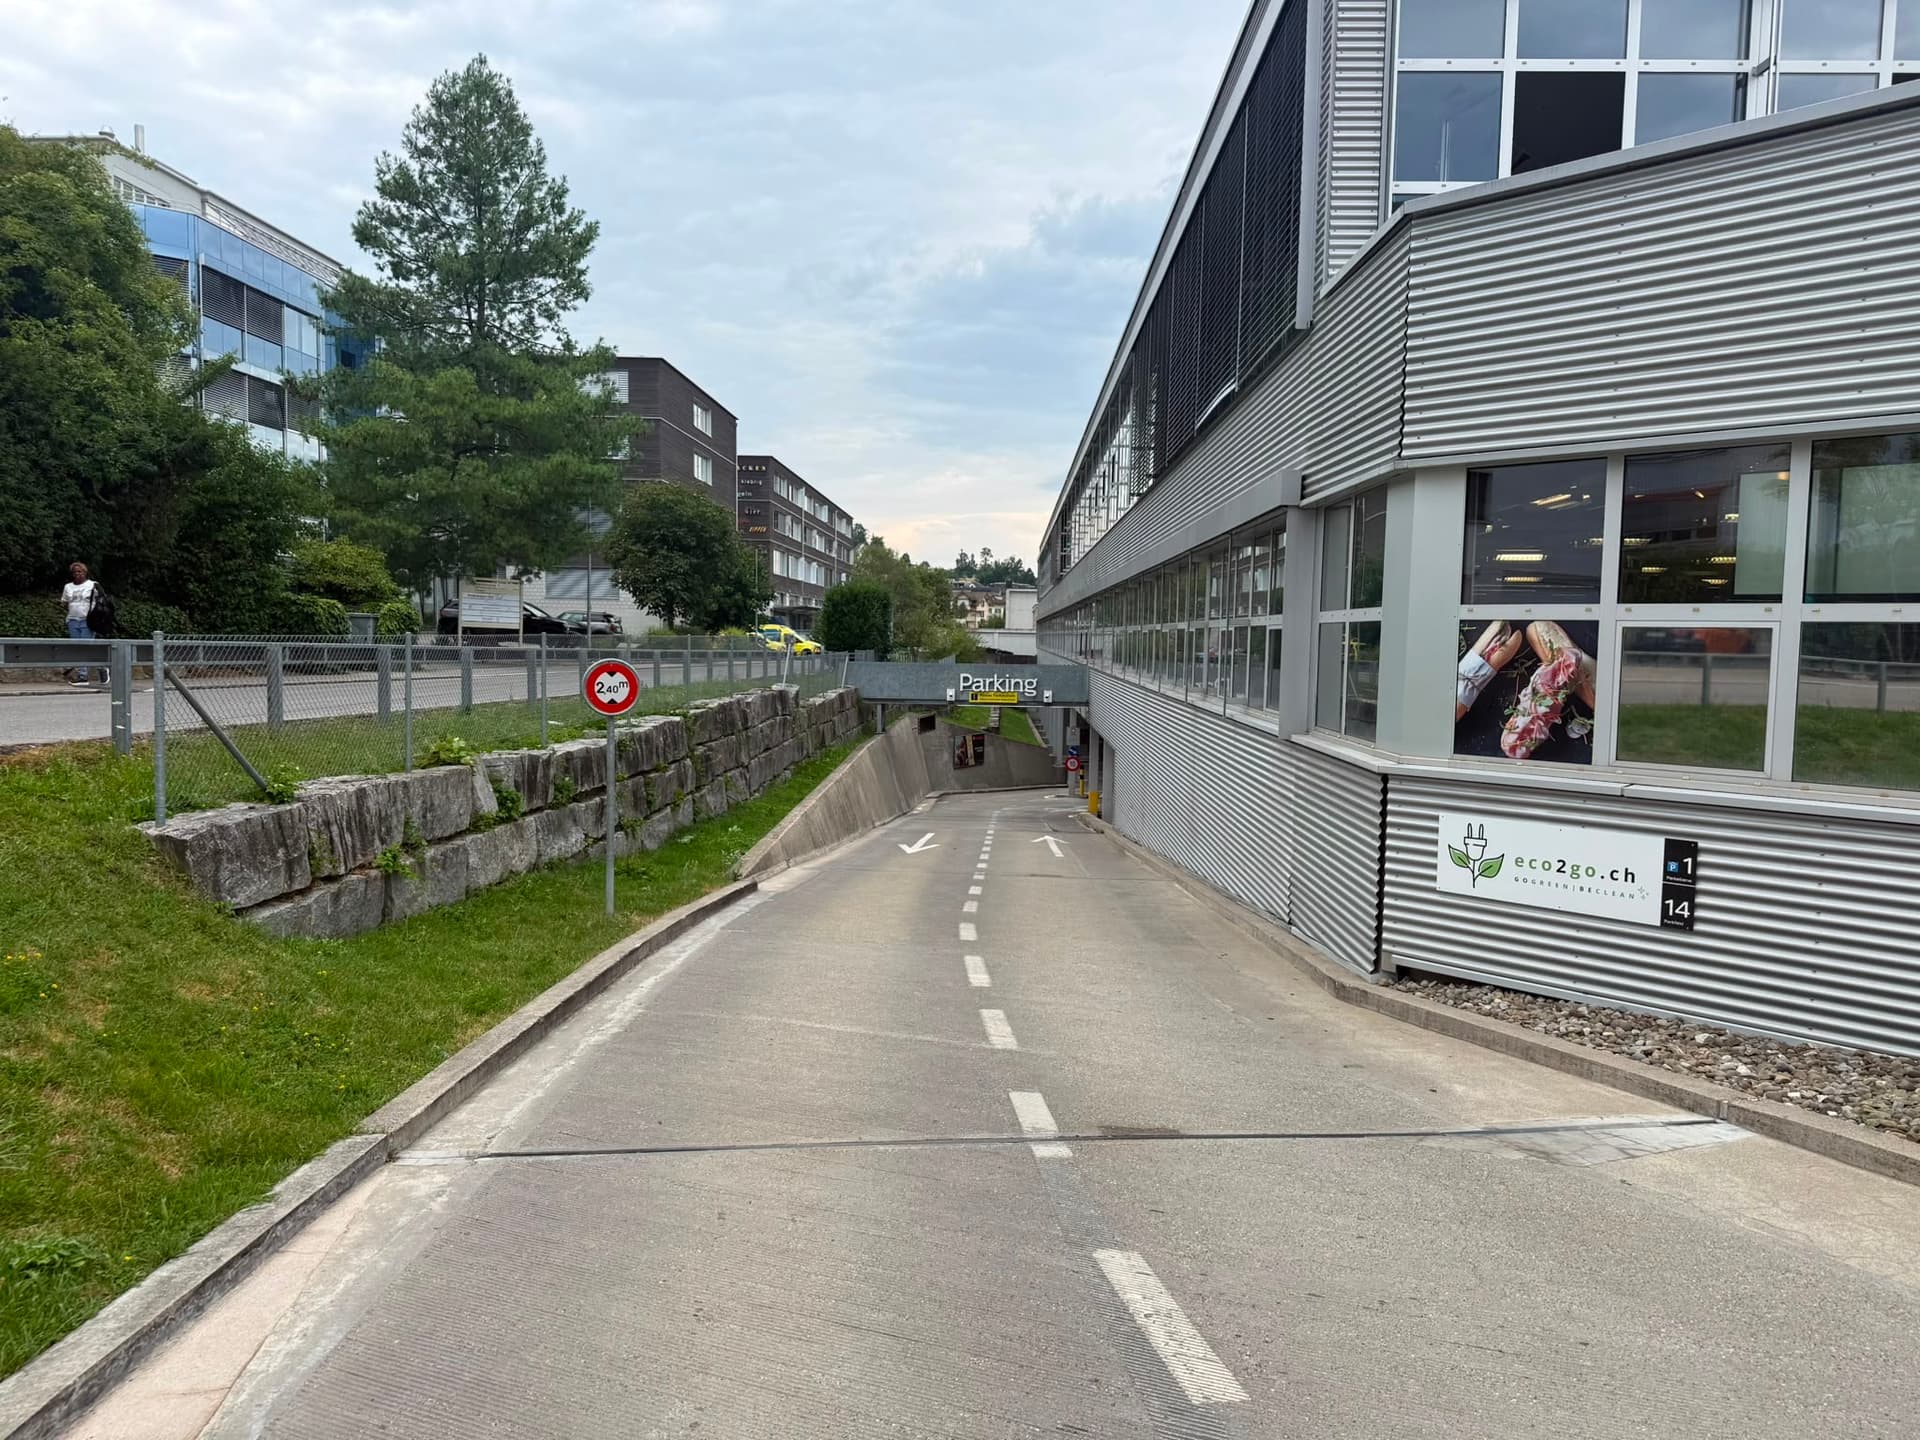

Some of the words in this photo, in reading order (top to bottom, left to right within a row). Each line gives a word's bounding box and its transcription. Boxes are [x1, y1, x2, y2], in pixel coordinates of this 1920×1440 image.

[959, 673, 1038, 697] Parking
[1514, 856, 1636, 884] eco2go.ch
[1682, 857, 1693, 875] 1
[1664, 898, 1691, 919] 14
